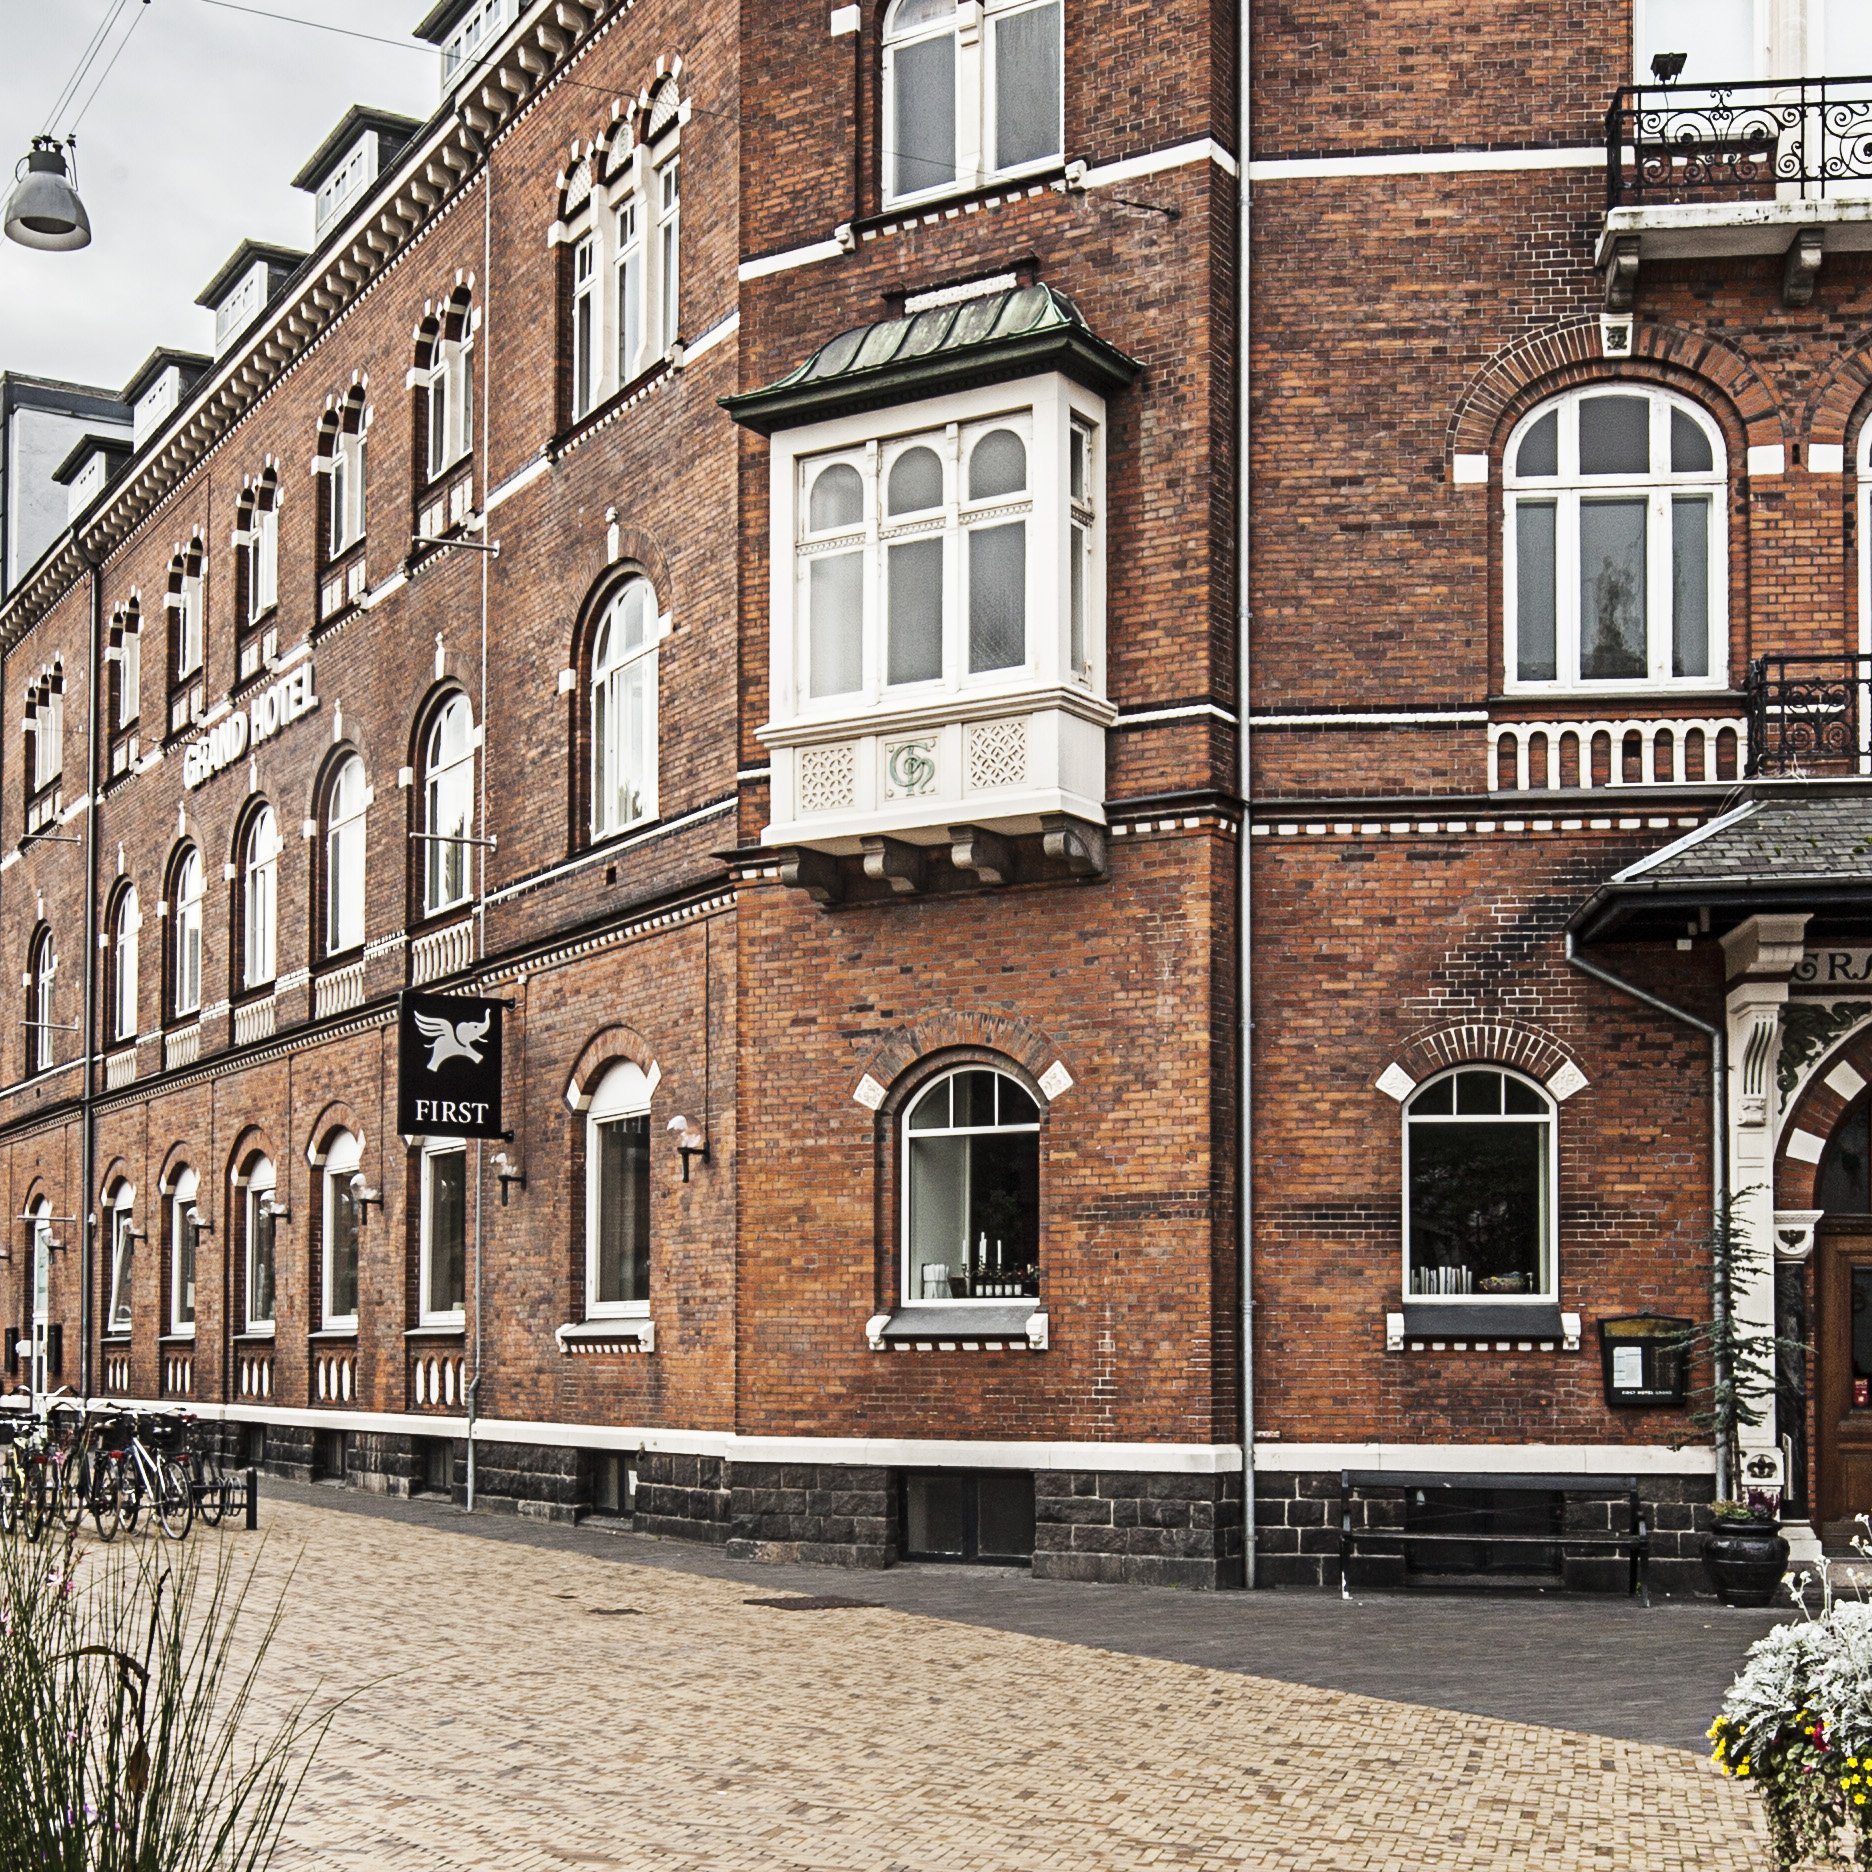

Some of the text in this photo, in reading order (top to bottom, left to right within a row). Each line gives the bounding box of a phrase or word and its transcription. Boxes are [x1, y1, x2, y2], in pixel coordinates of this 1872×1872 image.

[183, 661, 320, 791] GRAND HOTEL
[415, 1099, 489, 1124] FIRST
